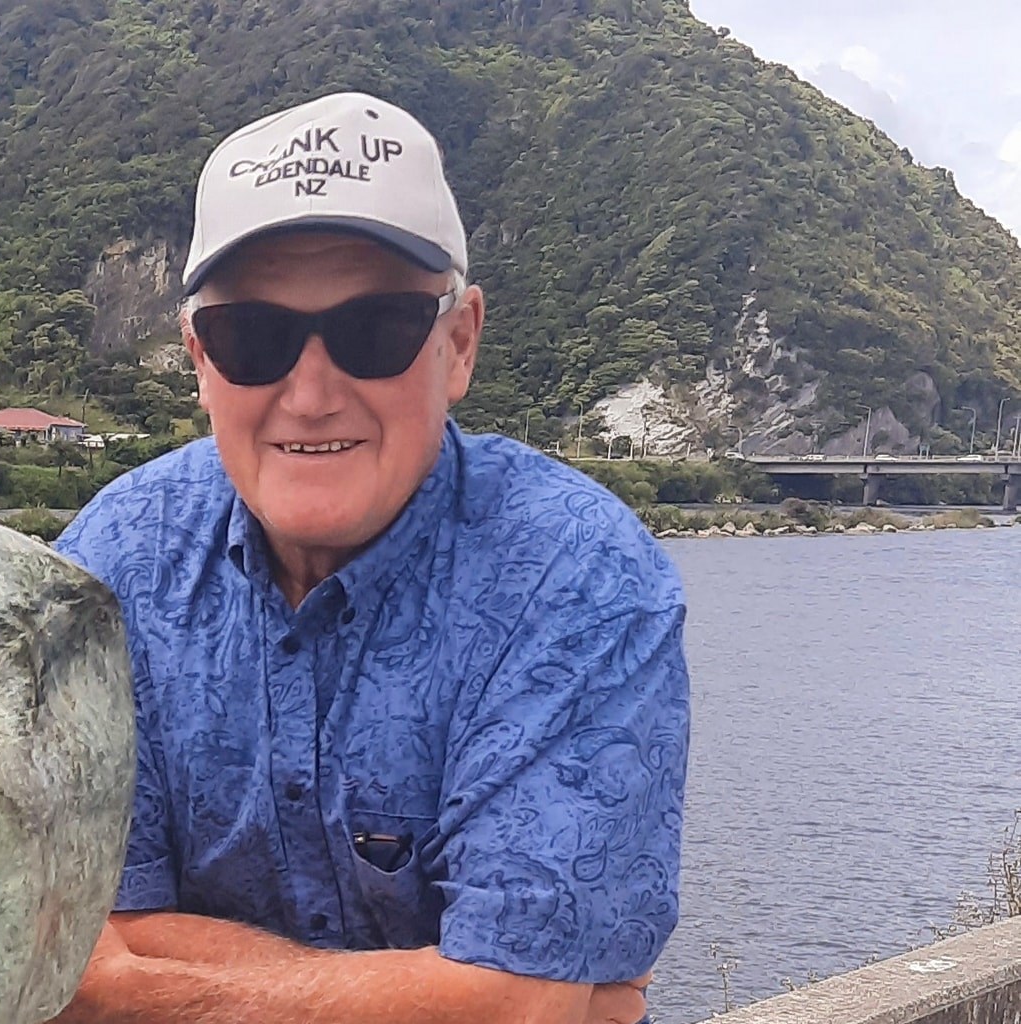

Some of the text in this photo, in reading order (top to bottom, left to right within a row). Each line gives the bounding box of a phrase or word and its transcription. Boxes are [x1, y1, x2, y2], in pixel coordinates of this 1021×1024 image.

[360, 133, 402, 162] UP
[254, 157, 371, 187] EDENDALE
[295, 179, 327, 197] NZ
